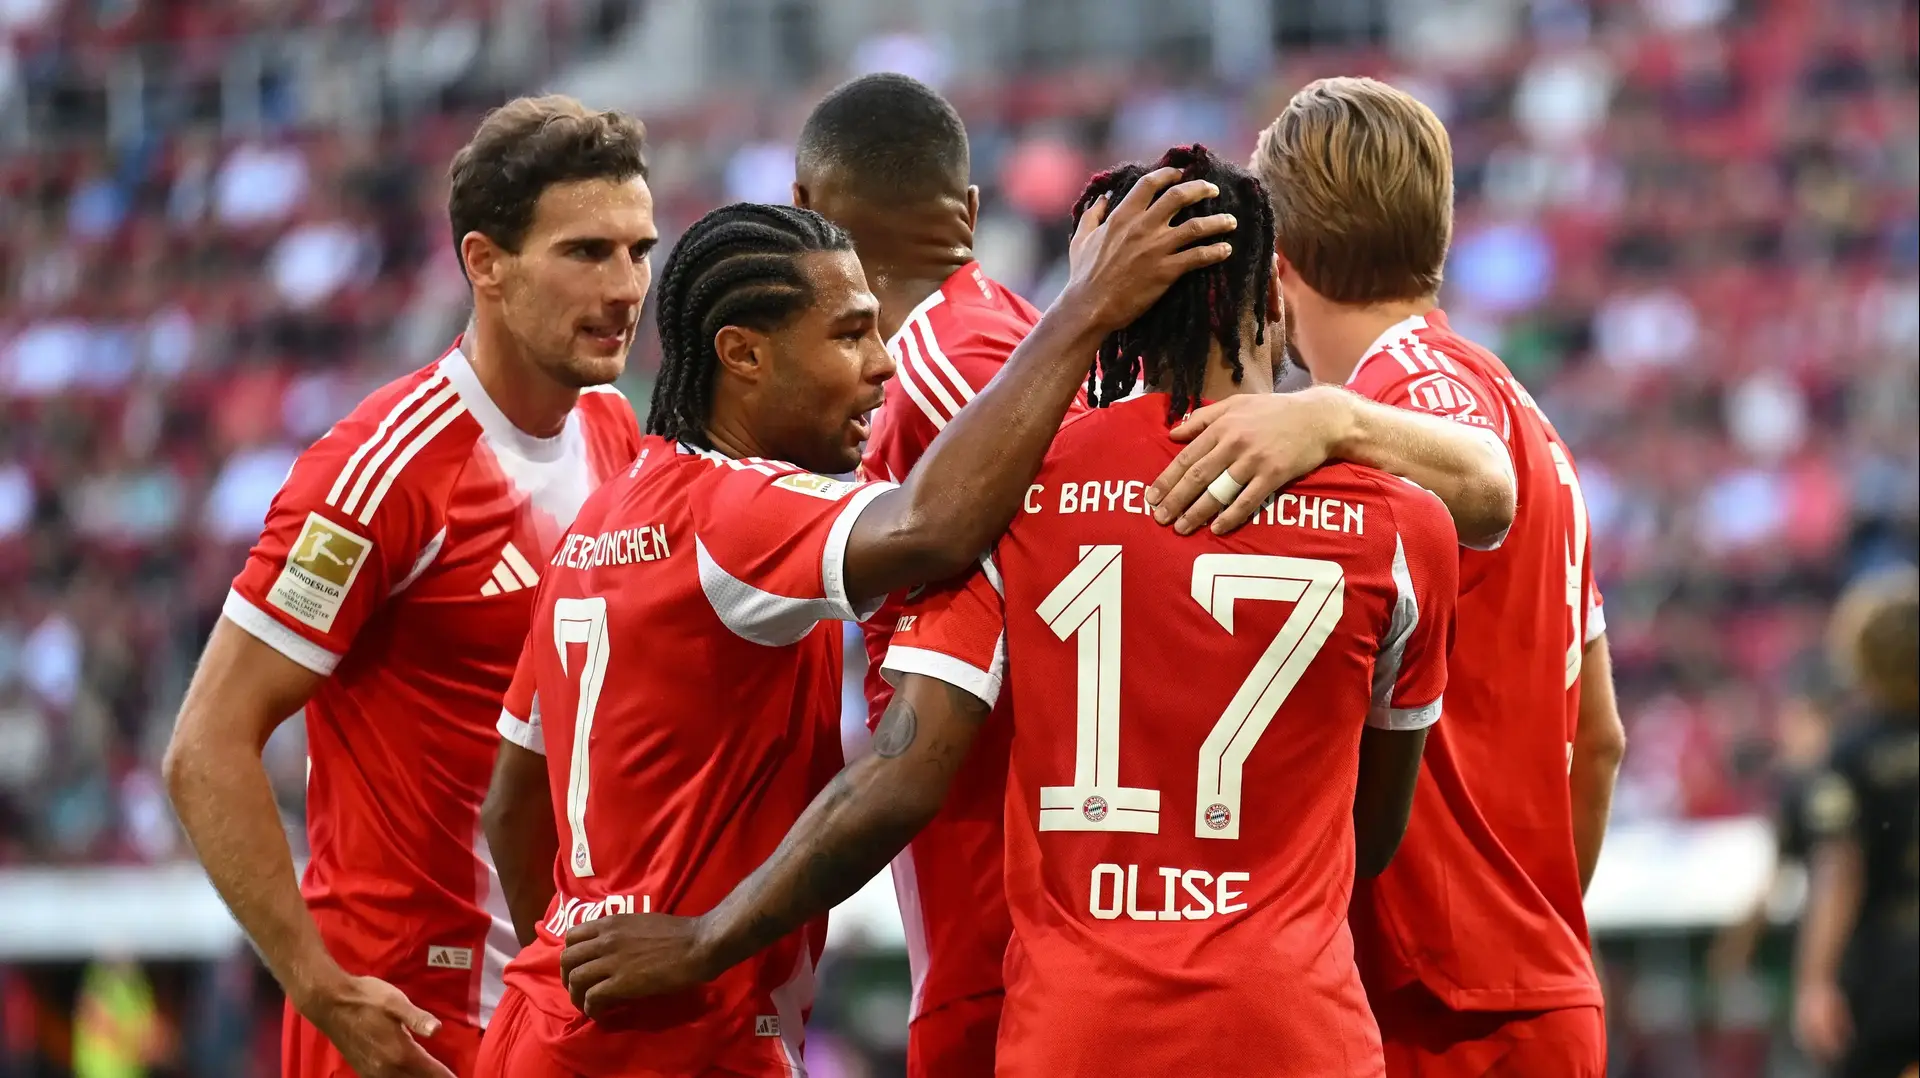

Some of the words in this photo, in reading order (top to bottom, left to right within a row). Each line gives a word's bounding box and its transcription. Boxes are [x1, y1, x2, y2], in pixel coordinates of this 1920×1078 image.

[1024, 484, 1045, 514] C
[1059, 480, 1159, 516] BAYE
[1252, 493, 1364, 535] NCHEN
[277, 588, 330, 619] FUSSBALLMEISTER
[288, 588, 322, 609] DEUTSCHER
[289, 566, 340, 598] BUNDESLIGA
[1035, 544, 1345, 839] 17
[553, 596, 610, 877] 7
[1089, 863, 1250, 921] OLISE
